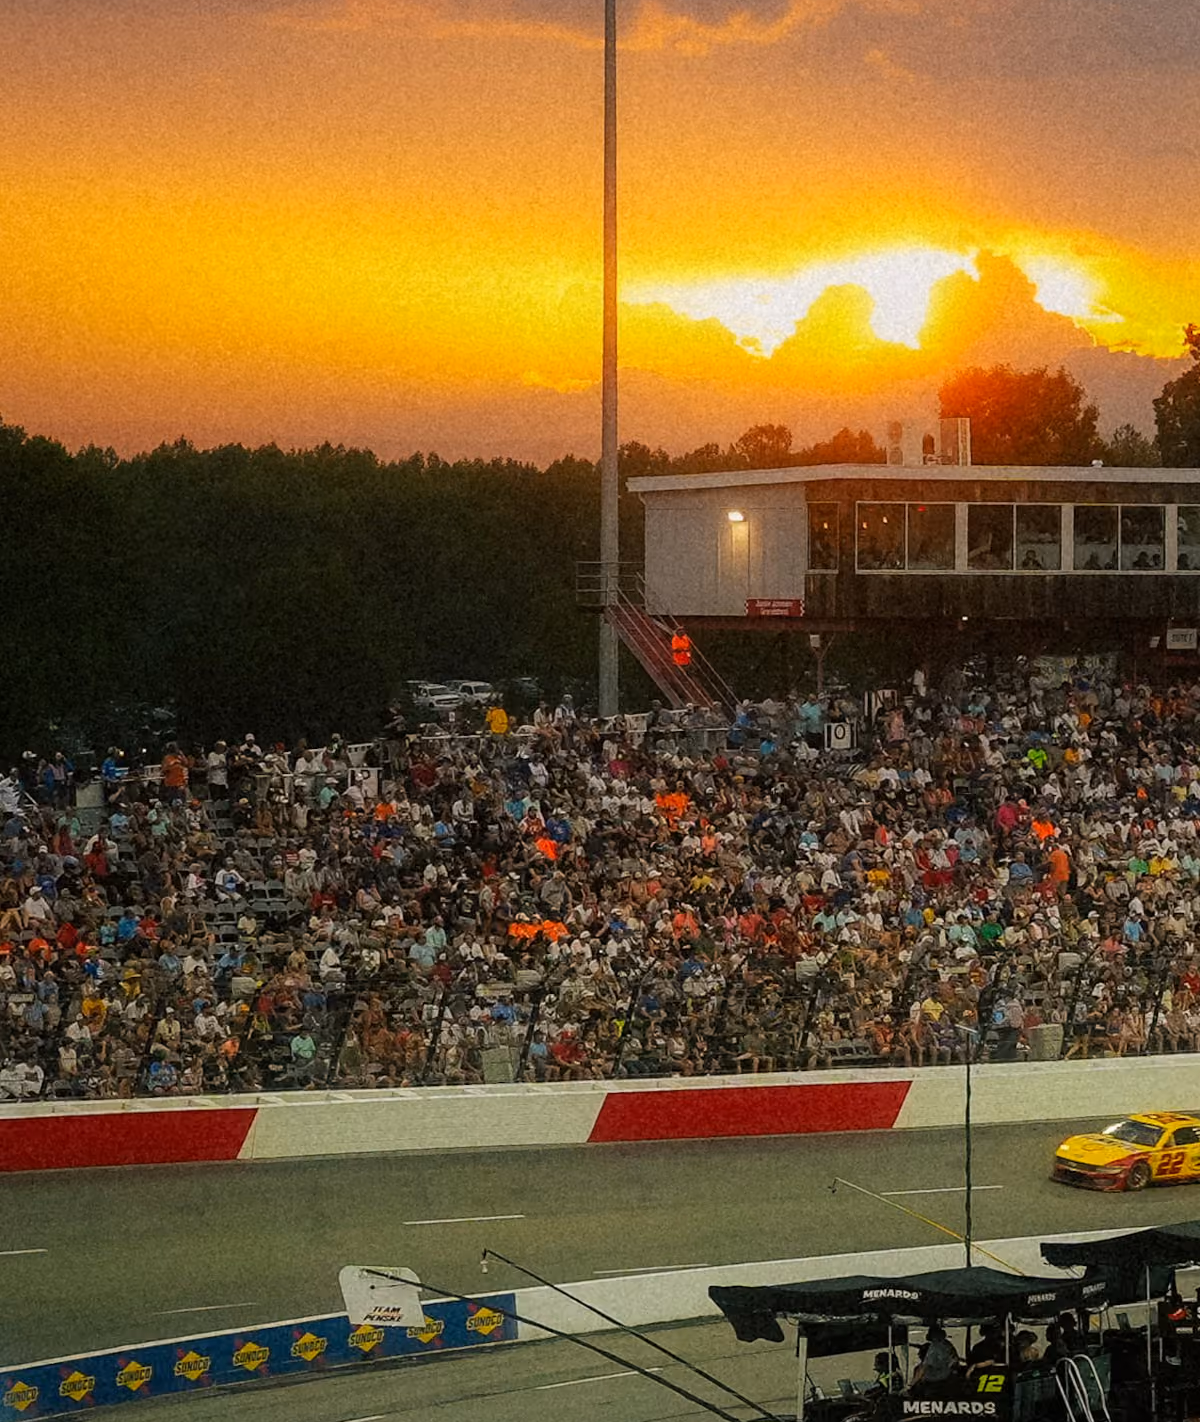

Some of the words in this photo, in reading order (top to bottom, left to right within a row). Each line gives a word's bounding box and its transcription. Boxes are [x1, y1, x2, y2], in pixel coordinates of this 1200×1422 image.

[1155, 1152, 1185, 1177] 22
[862, 1288, 919, 1300] MENARDS
[977, 1374, 1005, 1393] 12
[903, 1400, 996, 1415] MENARDS
